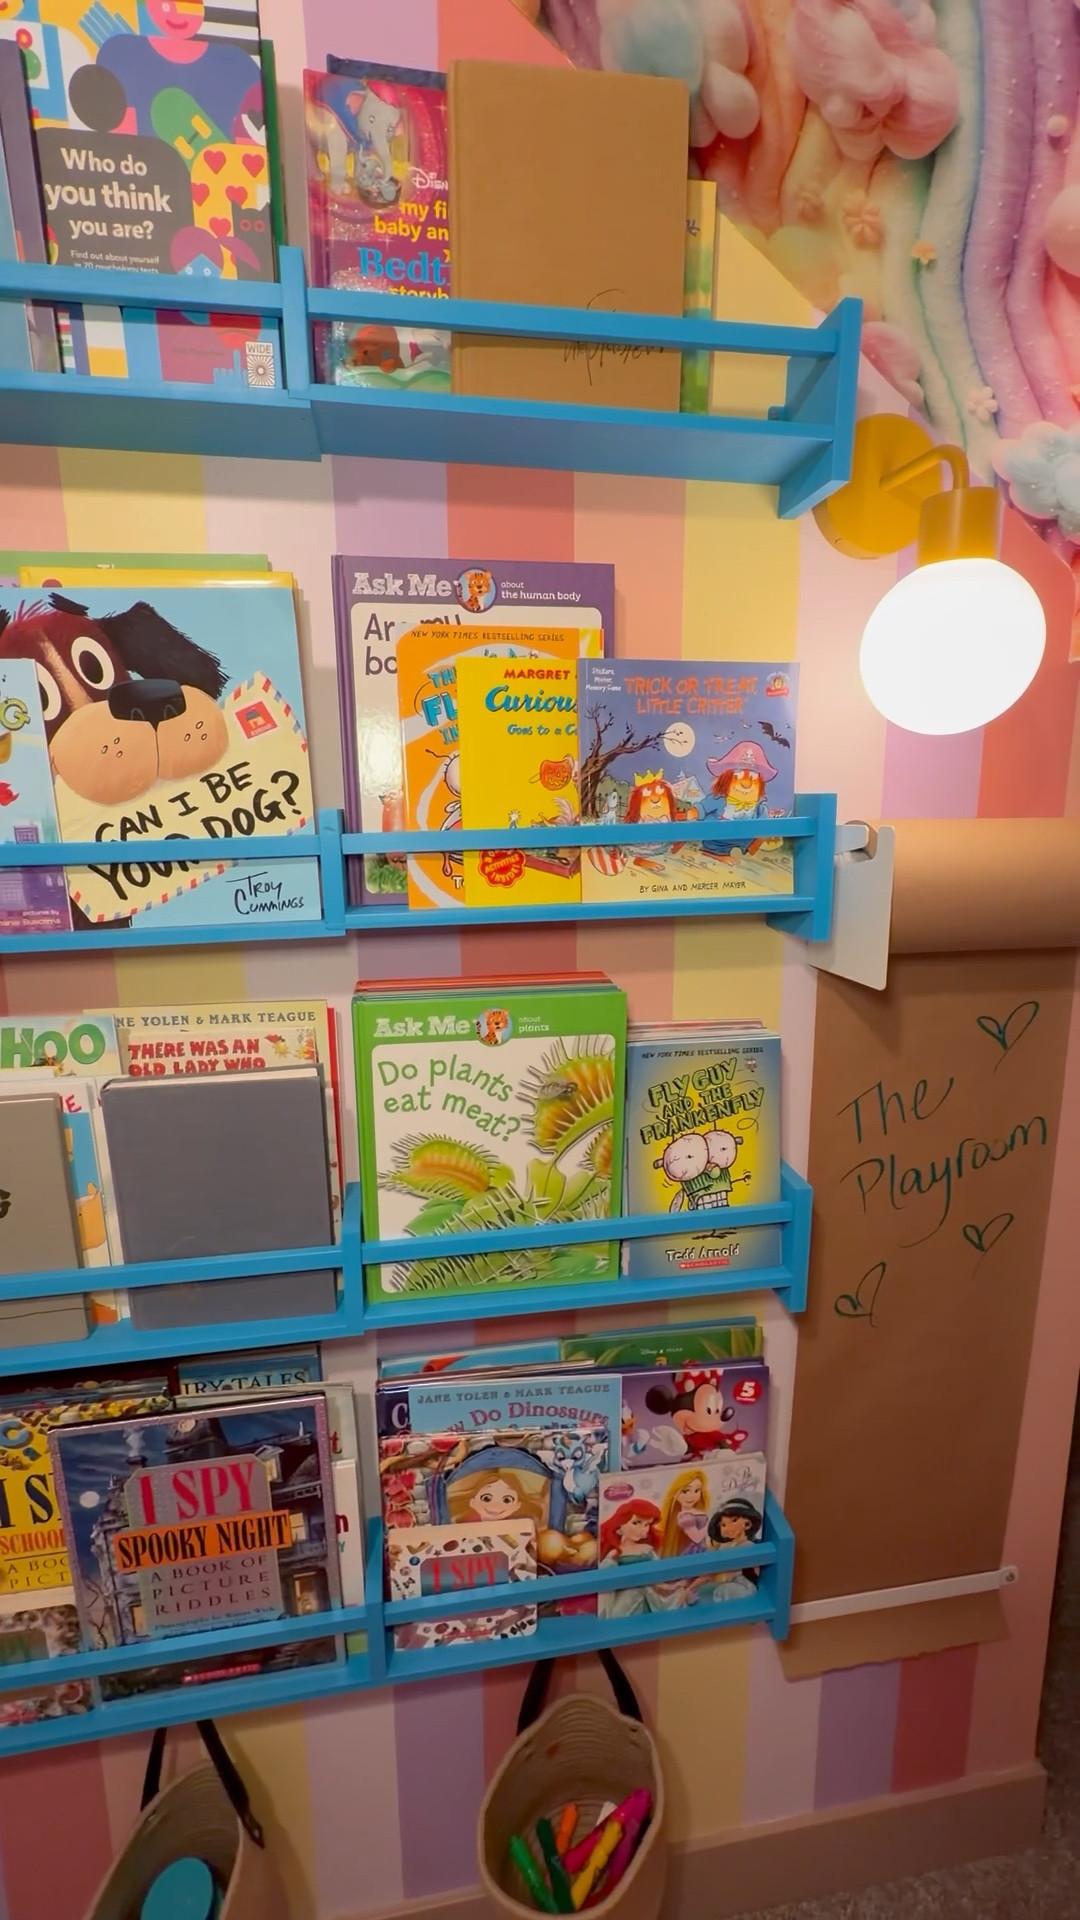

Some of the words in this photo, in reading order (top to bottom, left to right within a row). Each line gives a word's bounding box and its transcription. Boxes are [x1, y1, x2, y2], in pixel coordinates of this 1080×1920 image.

[60, 147, 116, 174] Who
[120, 154, 148, 176] do
[44, 183, 96, 211] you
[101, 181, 173, 213] think
[400, 201, 429, 222] my
[68, 219, 108, 240] you
[112, 220, 154, 240] are?
[374, 215, 421, 243] baby
[70, 249, 88, 259] Find
[105, 252, 127, 262] about
[247, 343, 272, 355] WIDE
[352, 572, 404, 596] Ask
[407, 573, 452, 597] Me
[500, 580, 524, 589] about
[501, 590, 519, 599] the
[520, 590, 556, 600] human
[557, 591, 581, 602] body
[410, 629, 428, 638] NEW
[431, 630, 450, 639] YORK
[452, 631, 478, 640] TIMES
[482, 632, 535, 641] BESTSELLING
[538, 633, 564, 642] SERIES
[503, 668, 570, 680] MARGRET
[624, 677, 672, 696] TRICK
[675, 677, 700, 695] OR
[484, 685, 578, 713] Curiou
[636, 697, 681, 715] LITTLE
[686, 697, 745, 715] CRITTER
[95, 804, 163, 842] CAN
[168, 791, 199, 816] I
[200, 761, 253, 803] BE
[200, 770, 302, 839] DOG?
[640, 885, 649, 894] BY
[651, 884, 669, 893] GINA
[672, 883, 688, 891] AND
[691, 882, 718, 891] MERCER
[722, 881, 747, 889] MAYER
[141, 1015, 190, 1026] YOLEN
[196, 1016, 204, 1025] &
[209, 1013, 253, 1024] MARK
[258, 1011, 316, 1023] TEAGUE
[373, 1016, 423, 1038] Ask
[427, 1015, 470, 1036] Me
[518, 1023, 550, 1033] plants
[128, 1042, 185, 1060] THERE
[189, 1039, 230, 1056] WAS
[232, 1038, 260, 1055] AN
[128, 1062, 166, 1077] OLD
[173, 1059, 220, 1075] LADY
[224, 1057, 266, 1070] WHO
[377, 1060, 418, 1087] Do
[429, 1054, 513, 1102] plants
[648, 1074, 690, 1108] FLY
[691, 1057, 738, 1091] GUY
[383, 1085, 432, 1113] eat
[441, 1092, 521, 1142] meat?
[663, 1096, 695, 1120] AND
[698, 1083, 733, 1105] THE
[836, 1076, 954, 1144] The
[640, 1086, 765, 1145] FRANKENFLY
[840, 1115, 1048, 1249] Playroom
[699, 1243, 740, 1258] Arnold
[417, 1393, 451, 1404] JANE
[456, 1391, 498, 1402] YOLEN
[515, 1386, 553, 1398] MARK
[558, 1383, 610, 1395] TEAGUE
[468, 1408, 502, 1428] Do
[508, 1401, 609, 1426] Dinosaurs
[138, 1475, 157, 1526] I
[172, 1460, 255, 1520] SPY
[117, 1525, 207, 1569] SPOOKY
[216, 1513, 288, 1555] NIGHT
[151, 1572, 162, 1584] A
[172, 1559, 231, 1580] BOOK
[241, 1554, 268, 1568] OF
[432, 1559, 442, 1593] I
[451, 1555, 499, 1589] SPY
[152, 1571, 270, 1599] PICTURE
[155, 1587, 271, 1616] RIDDLES
